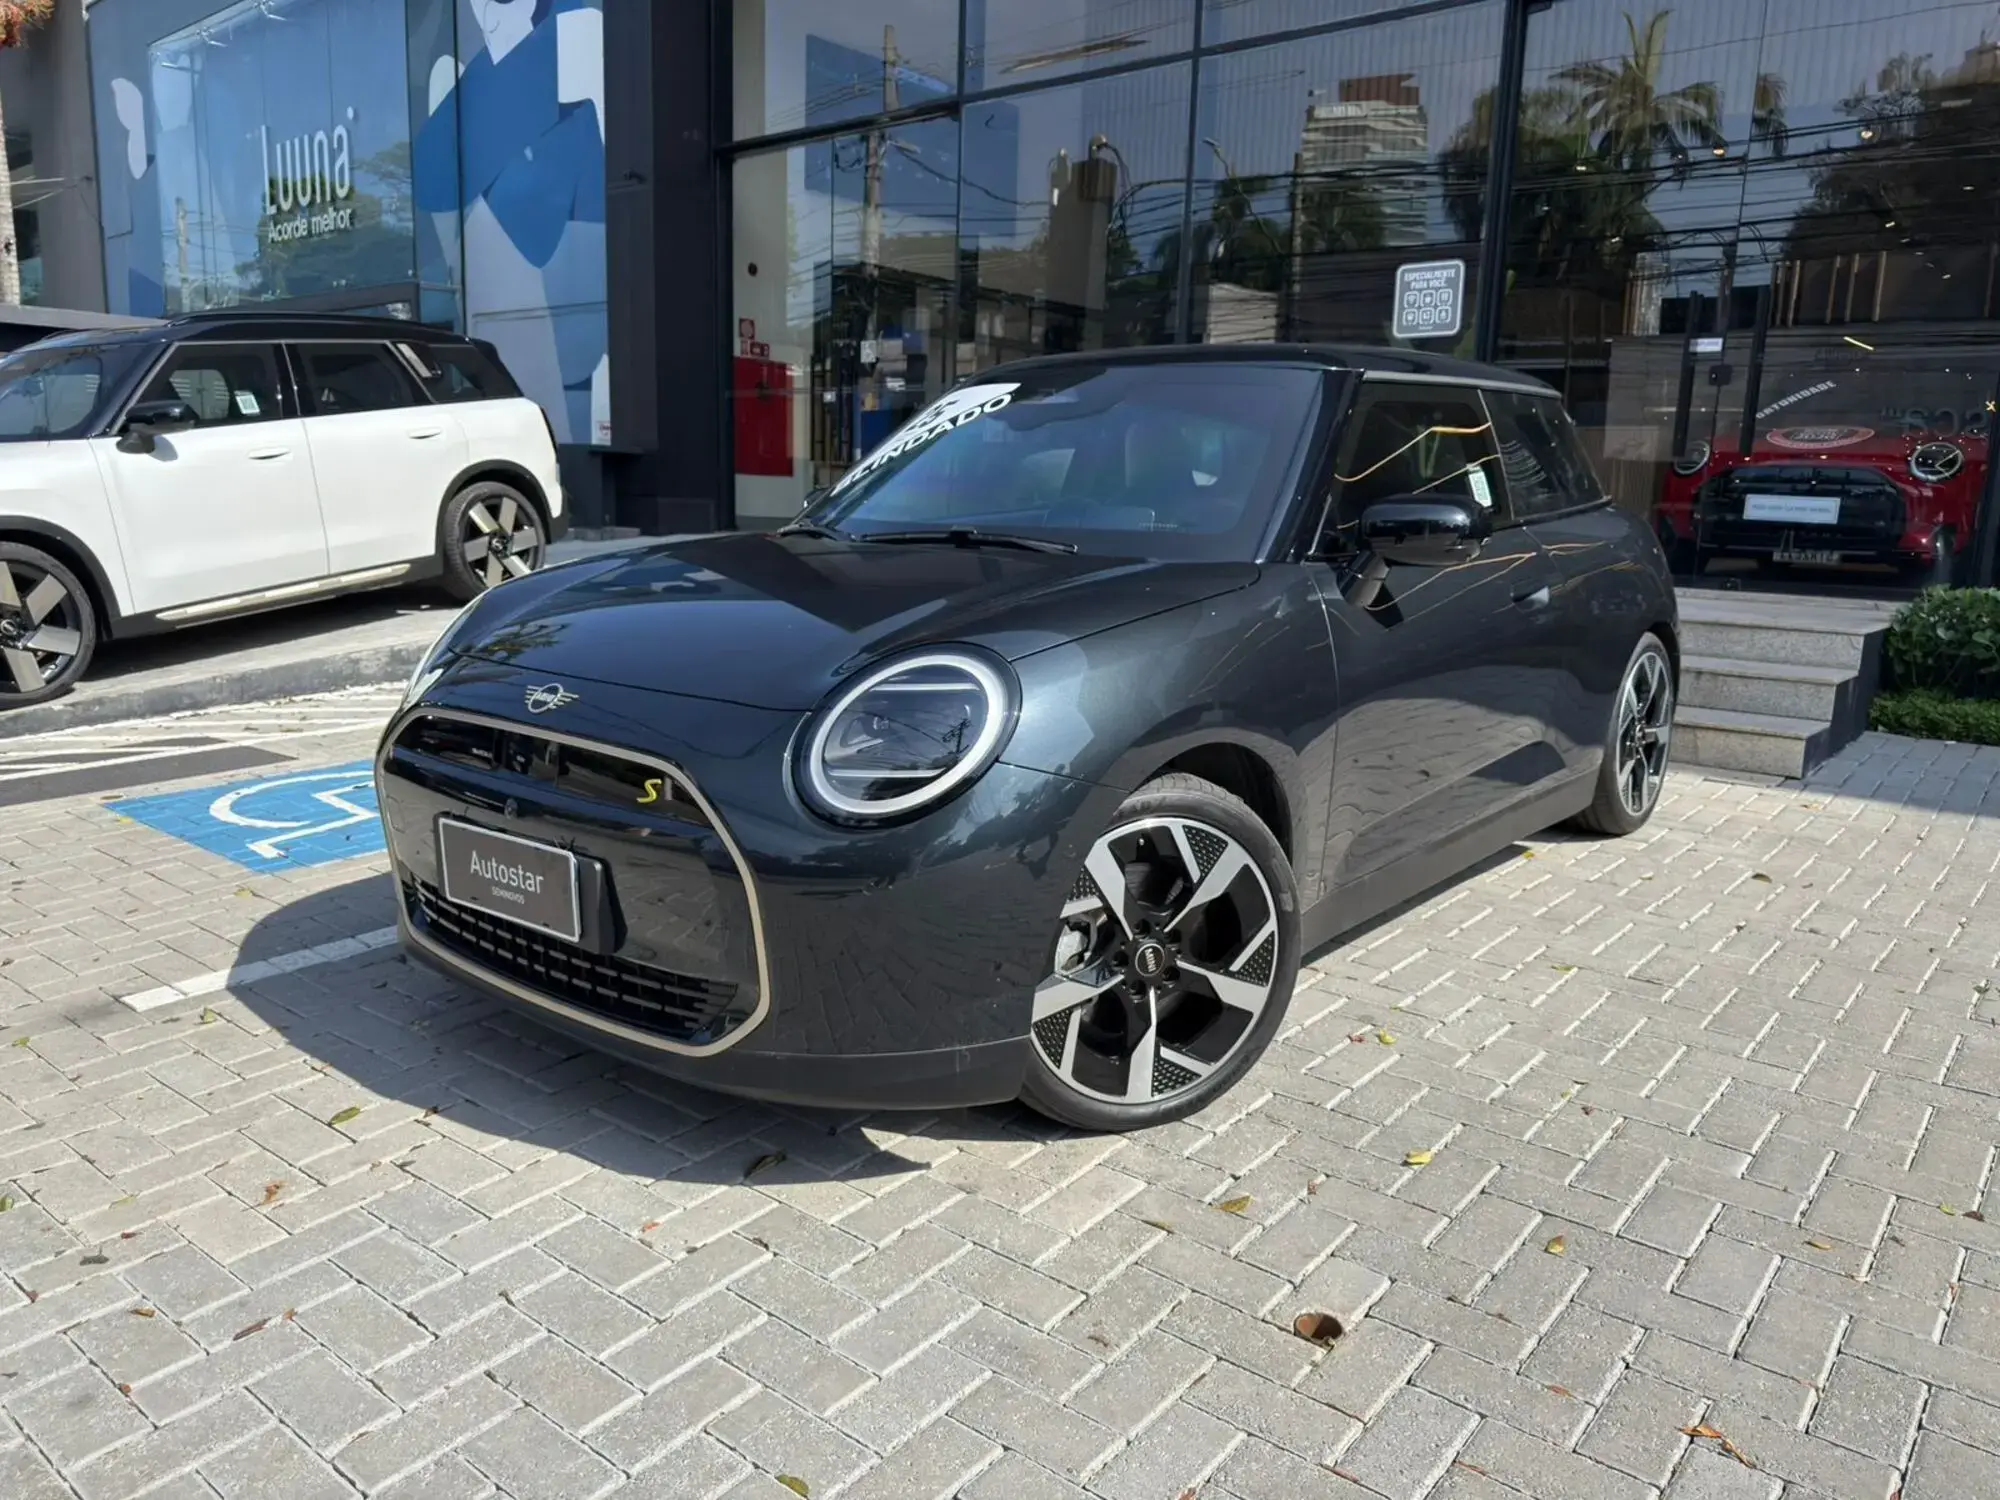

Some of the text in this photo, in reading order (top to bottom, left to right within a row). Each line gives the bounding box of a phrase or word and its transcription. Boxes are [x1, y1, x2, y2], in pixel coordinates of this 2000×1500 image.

[261, 125, 350, 215] Luuna
[268, 216, 308, 243] Acorde
[1755, 380, 1837, 420] ORTUNIDADE
[636, 778, 662, 803] S
[470, 850, 544, 894] Autostar
